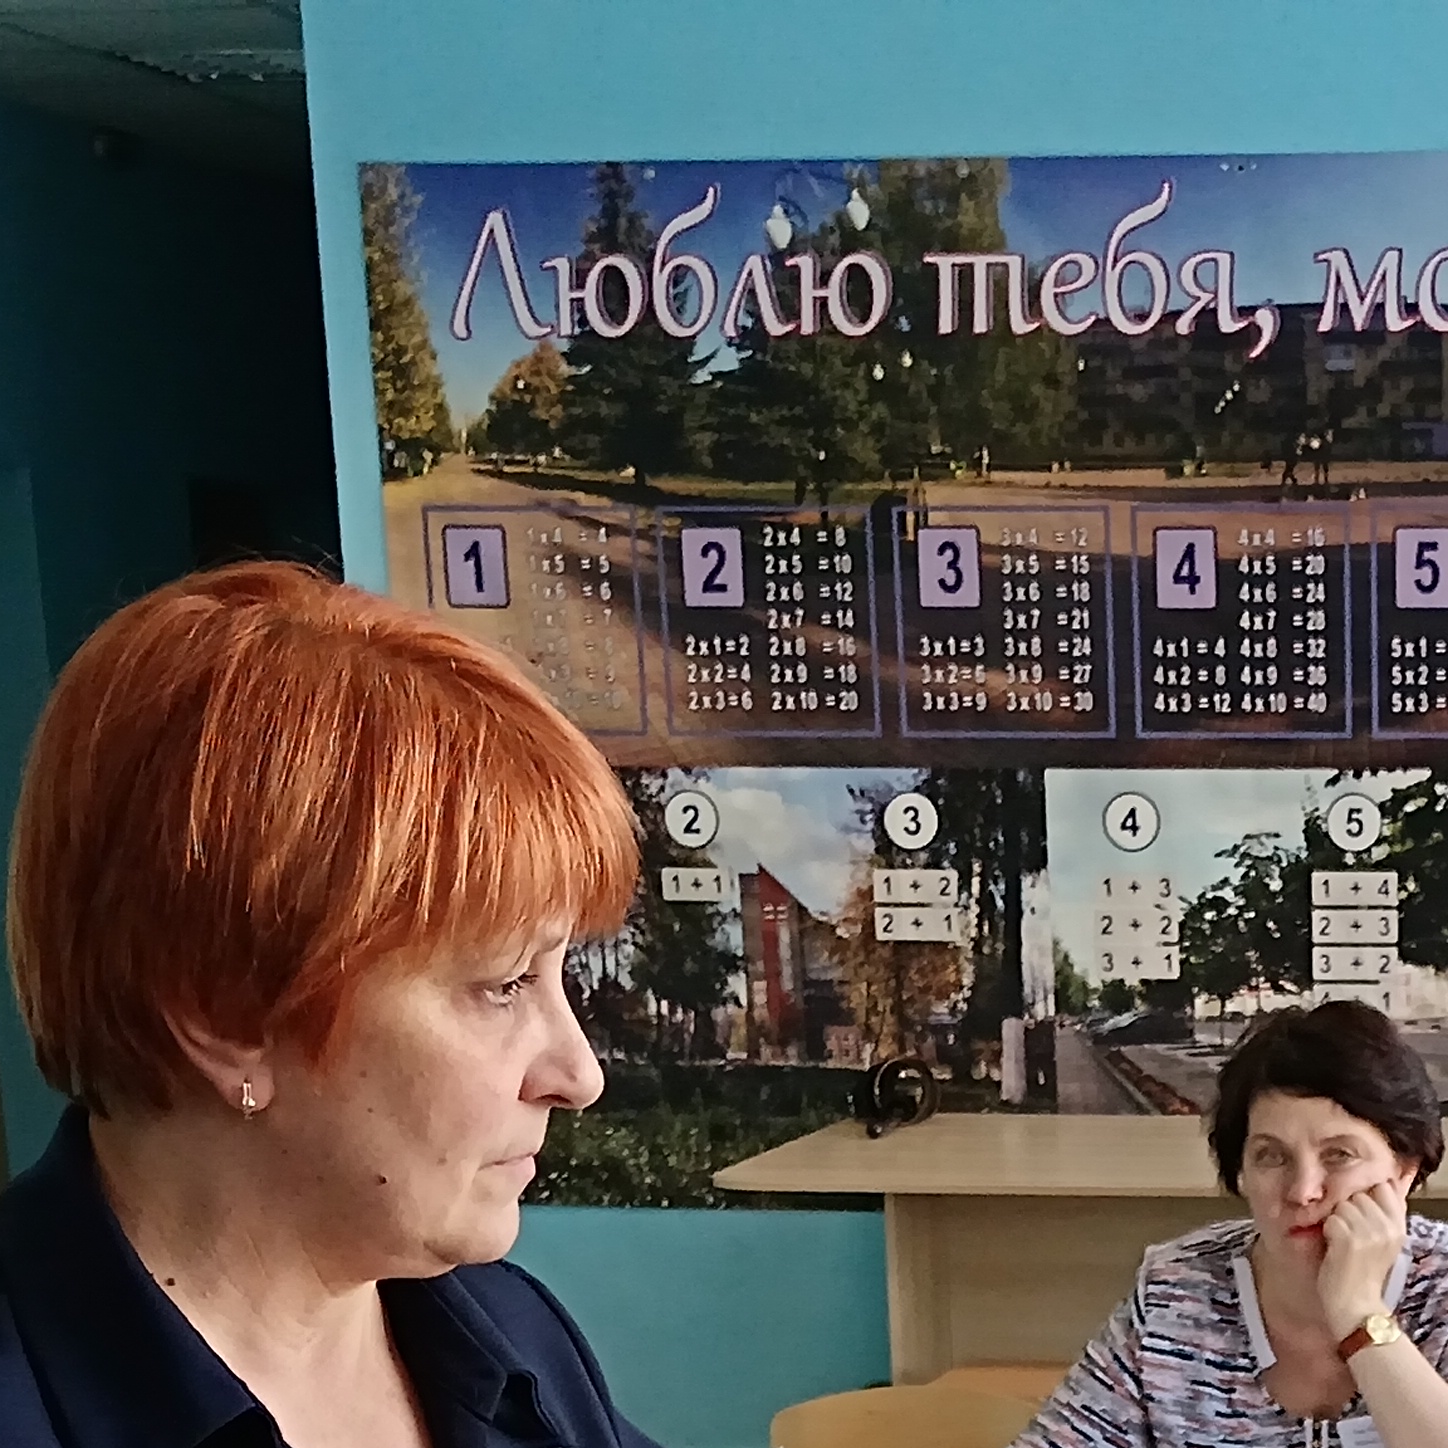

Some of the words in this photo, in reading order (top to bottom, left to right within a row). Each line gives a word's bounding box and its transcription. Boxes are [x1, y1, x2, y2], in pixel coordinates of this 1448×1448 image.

[449, 180, 891, 340] Люблю
[921, 177, 1281, 361] тебя,
[464, 540, 485, 593] 1
[700, 541, 728, 594] 2
[937, 541, 963, 594] 3
[1173, 542, 1200, 594] 4
[1414, 540, 1440, 594] 5
[682, 805, 701, 834] 2
[902, 805, 923, 835] 3
[1118, 806, 1142, 835] 4
[1346, 807, 1365, 838] 5
[670, 874, 681, 895] 1
[712, 874, 724, 895] 1
[882, 875, 893, 896] 1
[938, 875, 951, 896] 2
[1102, 877, 1112, 897] 1
[1158, 877, 1172, 897] 3
[1321, 878, 1331, 899] 1
[1377, 878, 1391, 899] 4
[881, 913, 894, 934] 2
[943, 913, 954, 934] 1
[1100, 914, 1114, 936] 2
[1159, 914, 1172, 936] 2
[1318, 916, 1331, 937] 2
[1377, 916, 1391, 937] 3
[1101, 952, 1115, 973] 3
[1164, 952, 1173, 973] 1
[1319, 954, 1332, 975] 3
[1377, 954, 1391, 975] 2
